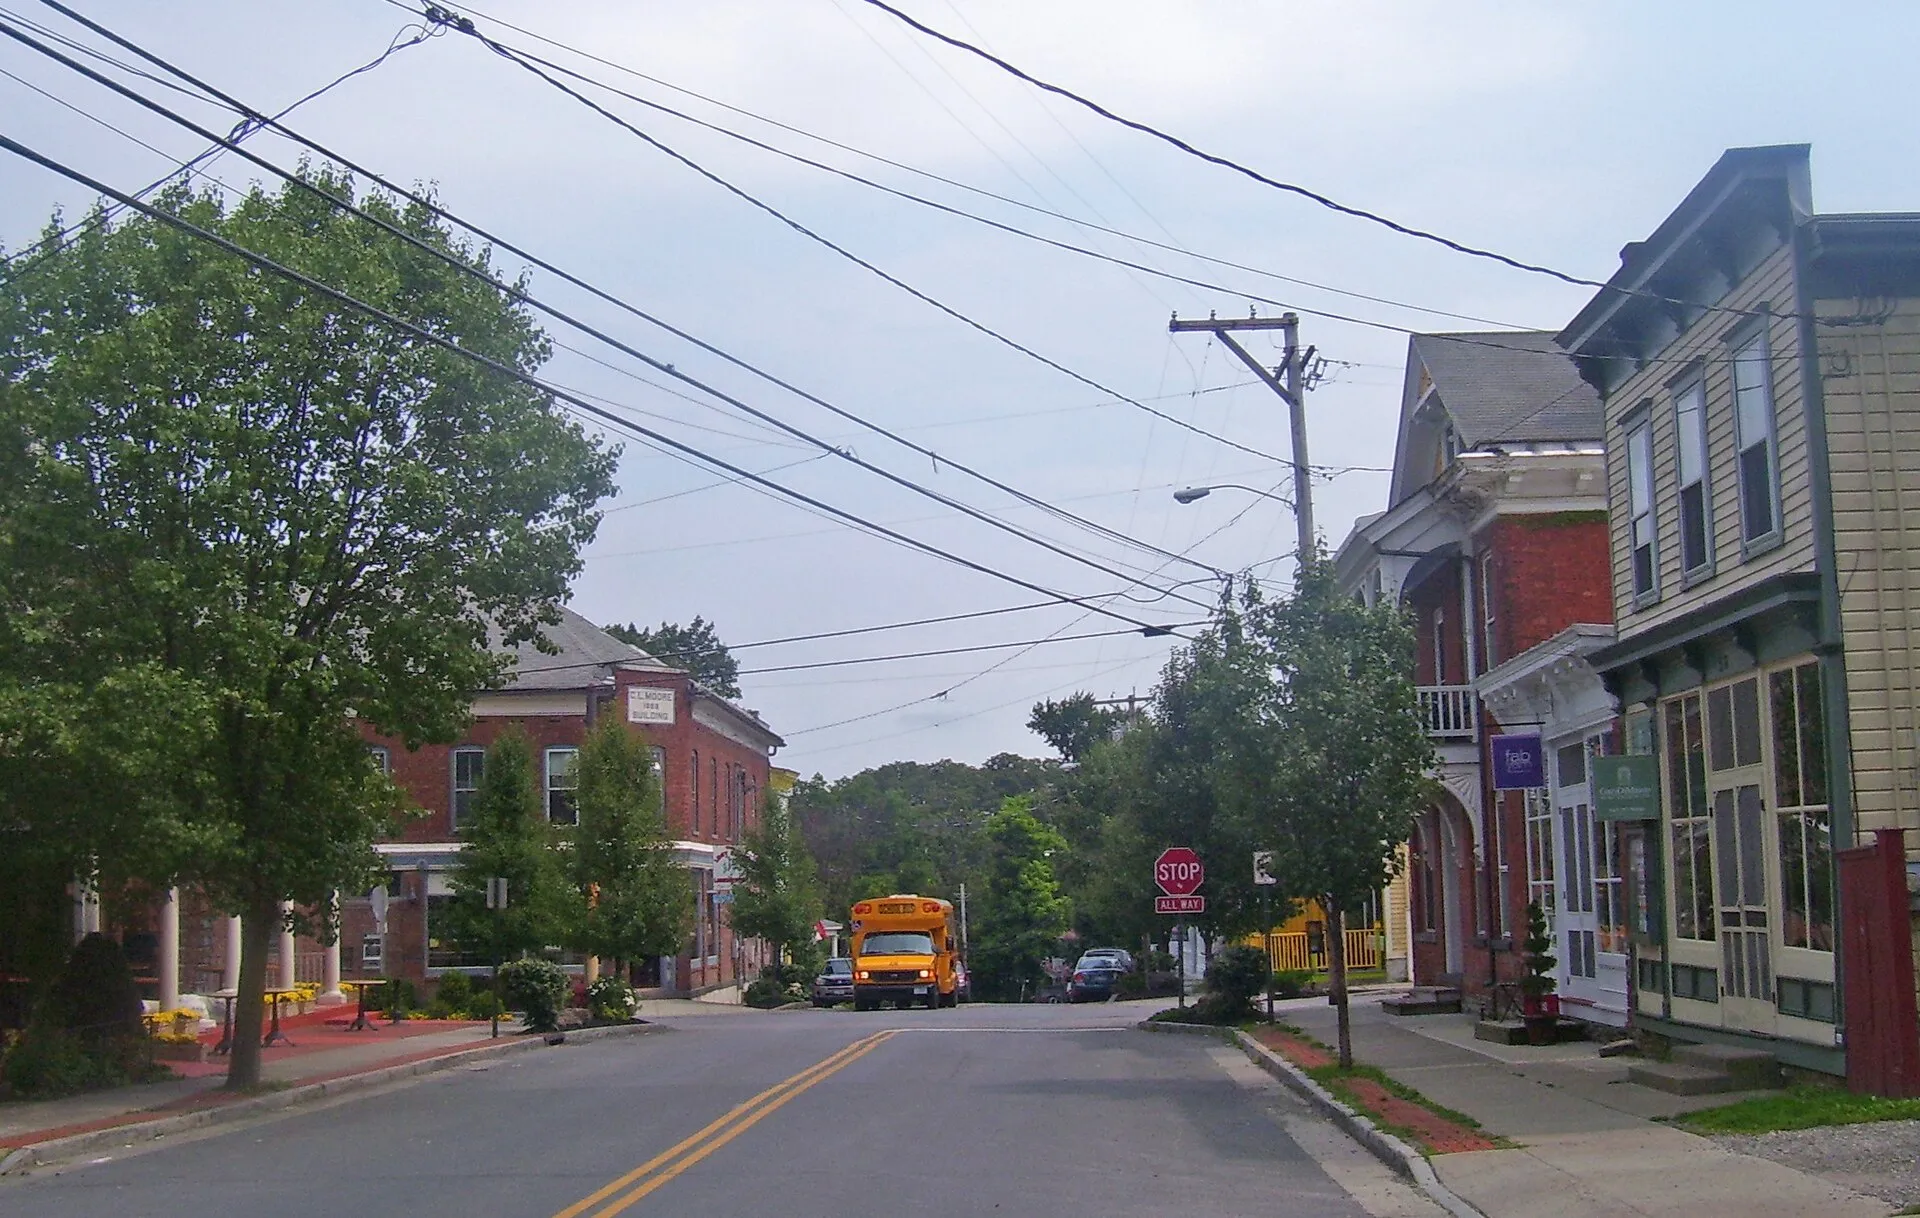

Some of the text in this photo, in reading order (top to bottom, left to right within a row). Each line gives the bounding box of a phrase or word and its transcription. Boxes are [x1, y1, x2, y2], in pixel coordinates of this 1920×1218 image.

[645, 692, 673, 701] MOORE
[633, 711, 668, 720] BUILDING
[1505, 749, 1531, 762] fab
[1159, 863, 1200, 880] STOP
[1160, 899, 1199, 909] ALL WAY
